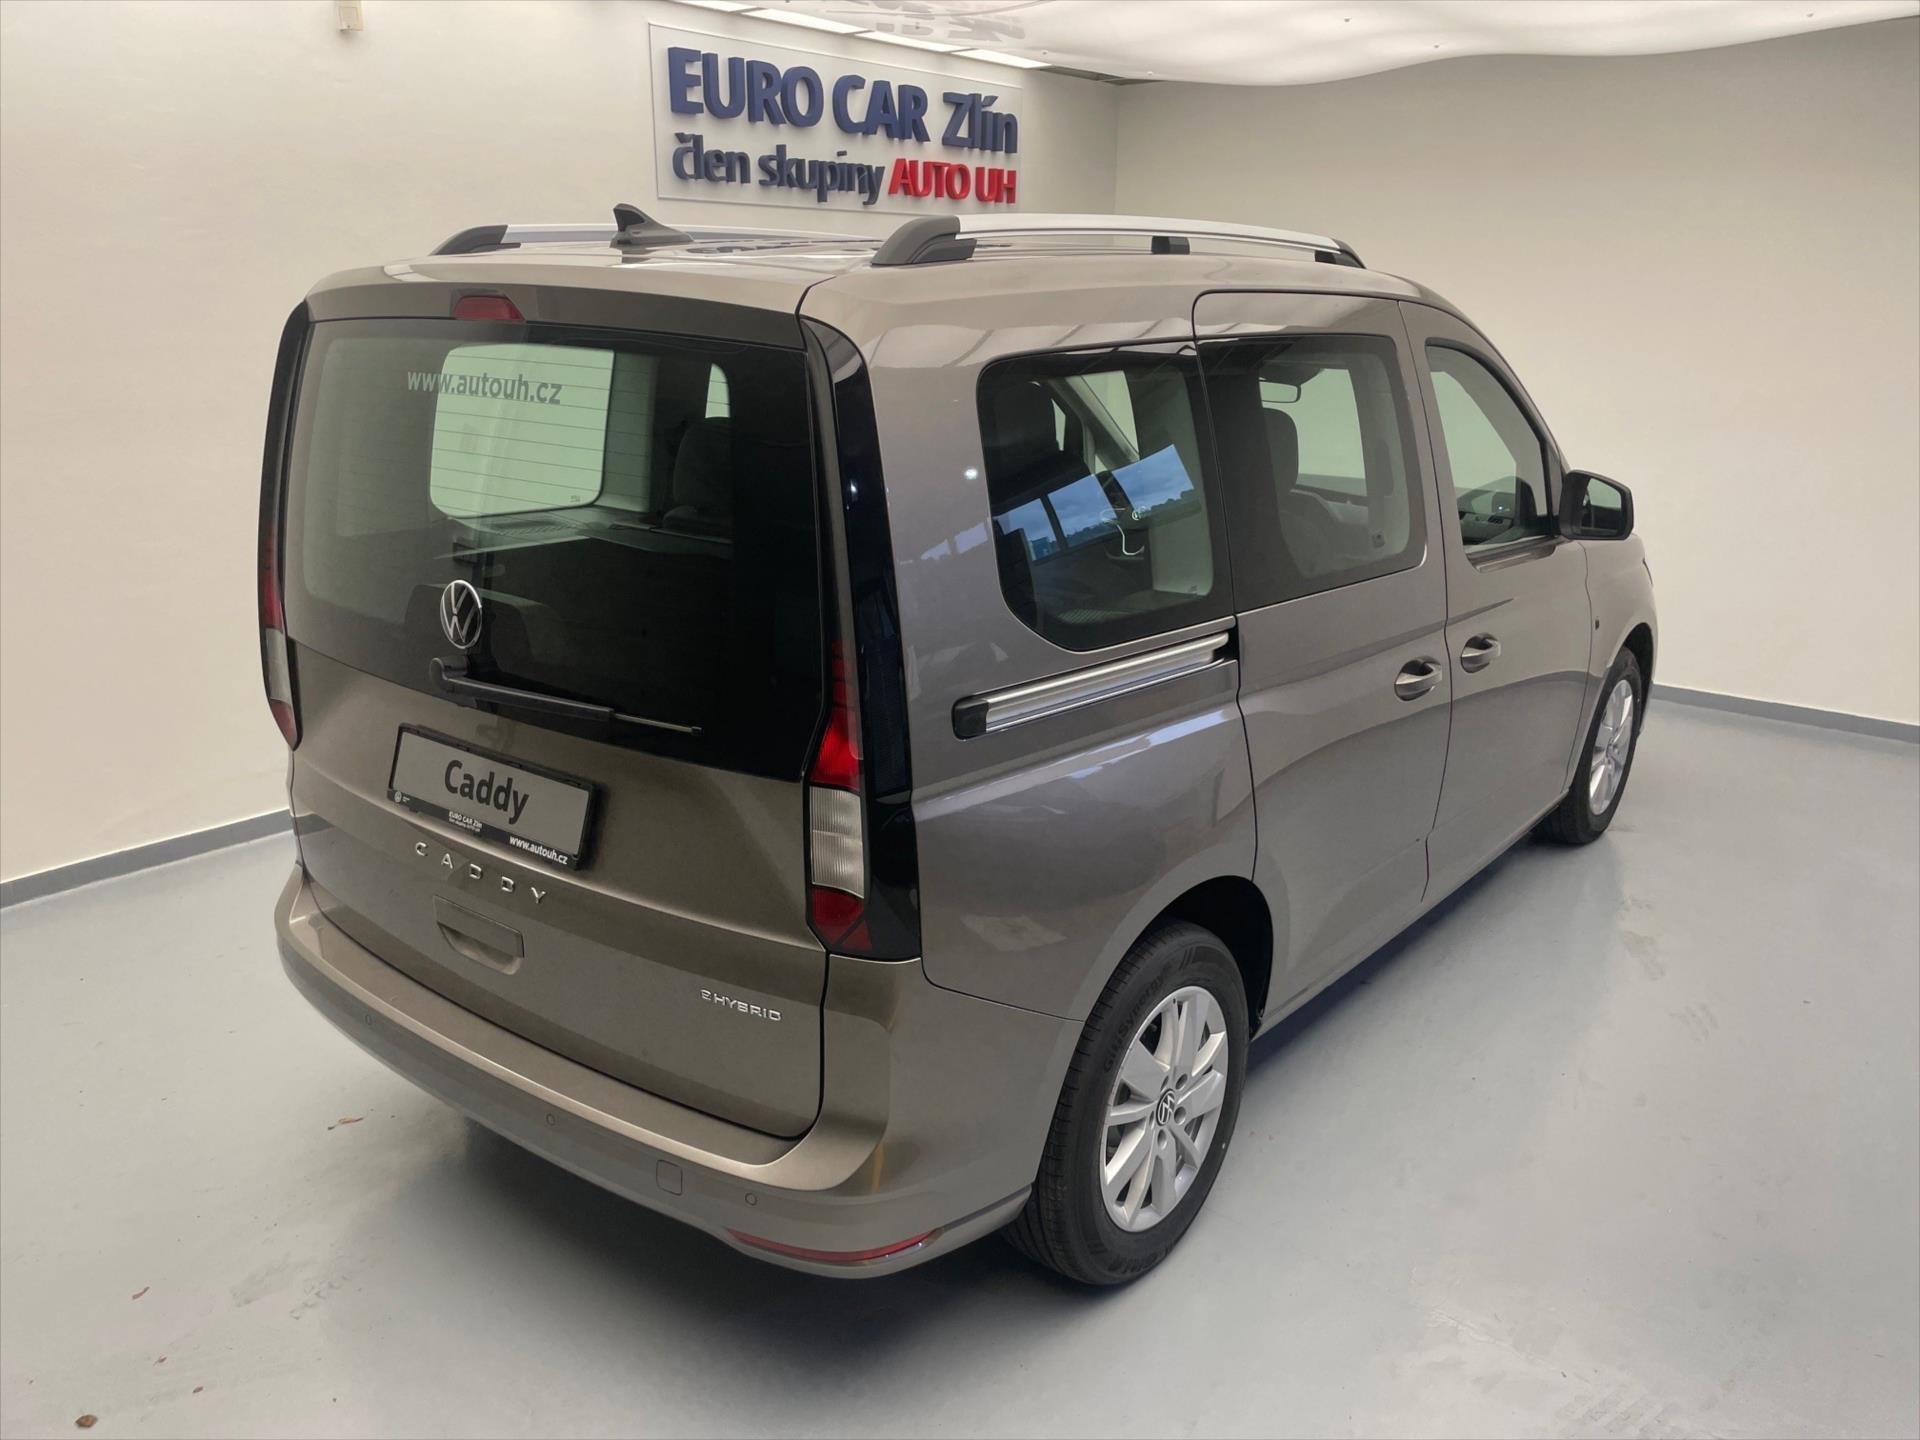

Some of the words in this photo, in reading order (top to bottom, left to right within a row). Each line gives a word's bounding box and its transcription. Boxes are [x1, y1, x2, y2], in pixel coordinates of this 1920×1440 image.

[667, 47, 824, 127] EURO
[832, 74, 931, 142] CAR
[942, 91, 1018, 153] Zlín
[672, 132, 751, 184] člen
[758, 144, 885, 206] skupiny
[888, 158, 971, 200] AUTO
[975, 166, 1017, 204] UH
[407, 371, 562, 405] www.autouh.cz
[445, 759, 530, 825] Caddy
[415, 841, 546, 904] CADDY
[509, 835, 568, 865] www.autouh.cz
